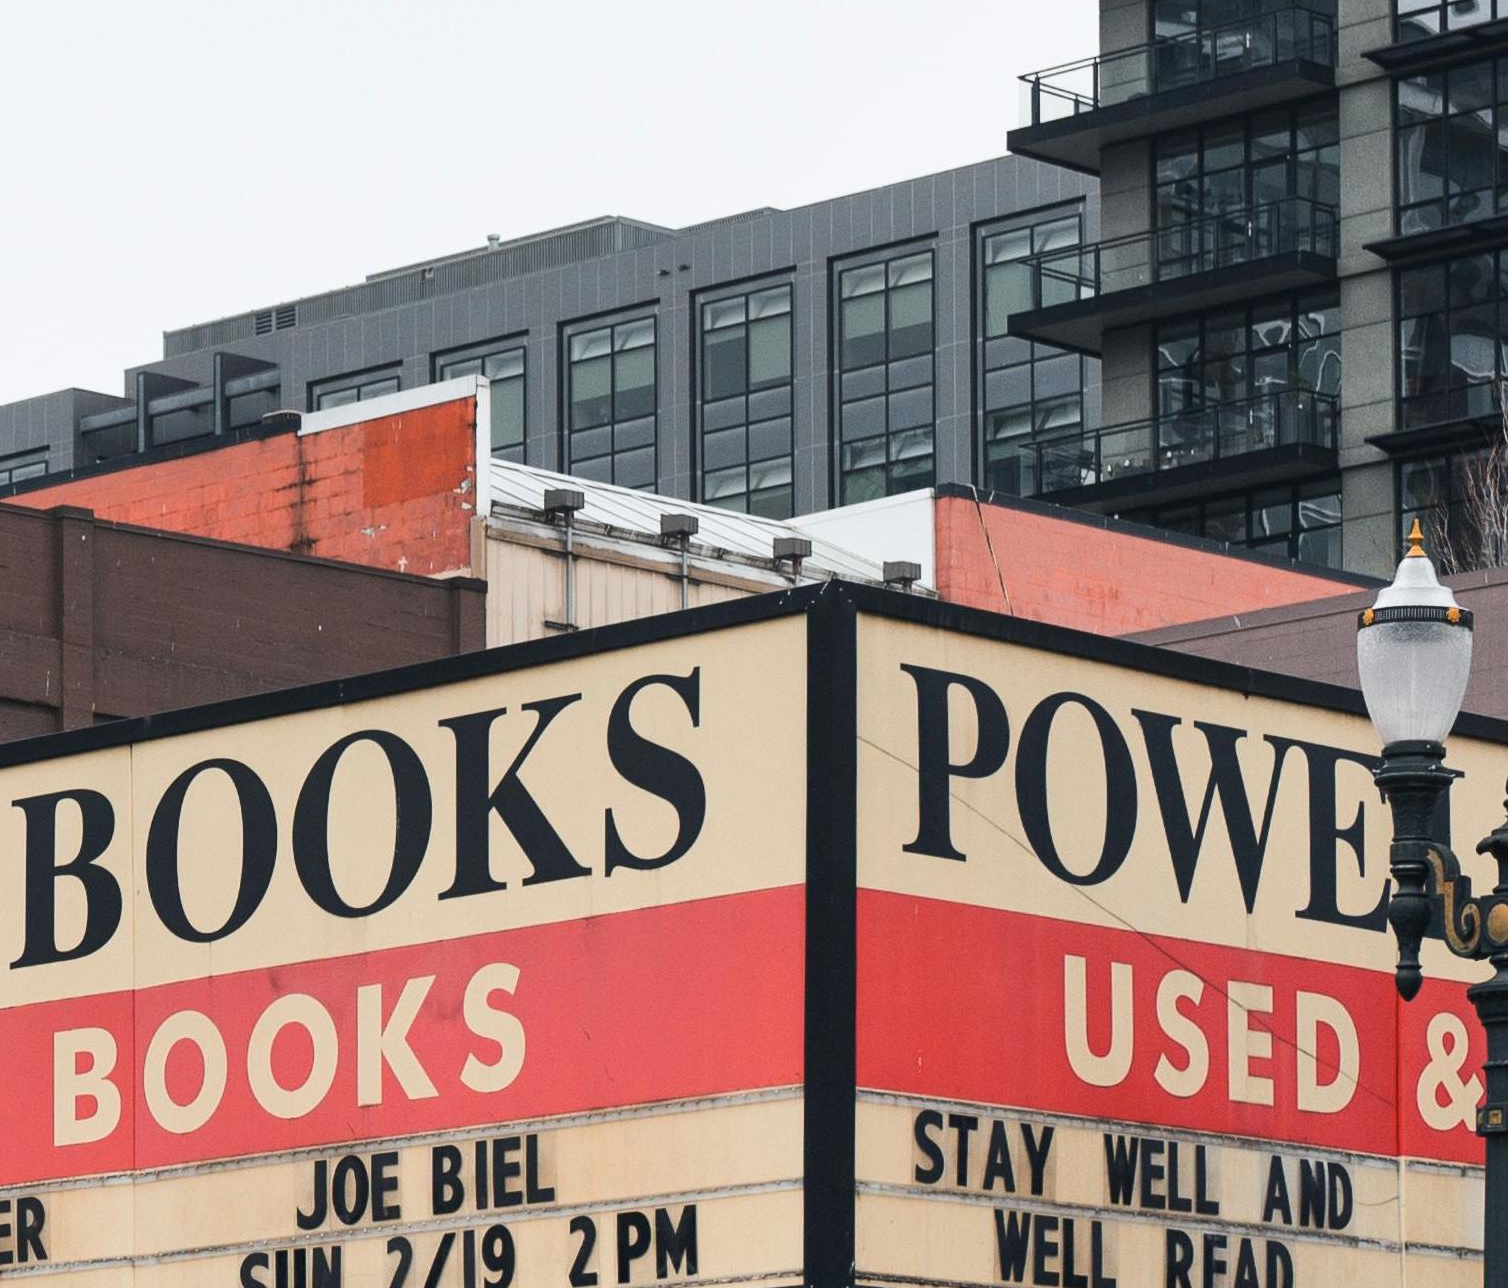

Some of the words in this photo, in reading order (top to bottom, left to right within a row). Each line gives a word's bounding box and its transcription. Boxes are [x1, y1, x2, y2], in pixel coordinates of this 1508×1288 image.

[9, 666, 707, 970] BOOKS
[53, 962, 527, 1147] BOOKS
[1063, 954, 1361, 1114] USED
[1416, 1011, 1484, 1132] &
[297, 1151, 403, 1230] JOE
[432, 1133, 556, 1216] BIEL
[913, 1110, 1054, 1198] STAY
[1104, 1133, 1220, 1218] WELL
[1263, 1154, 1354, 1232] AND
